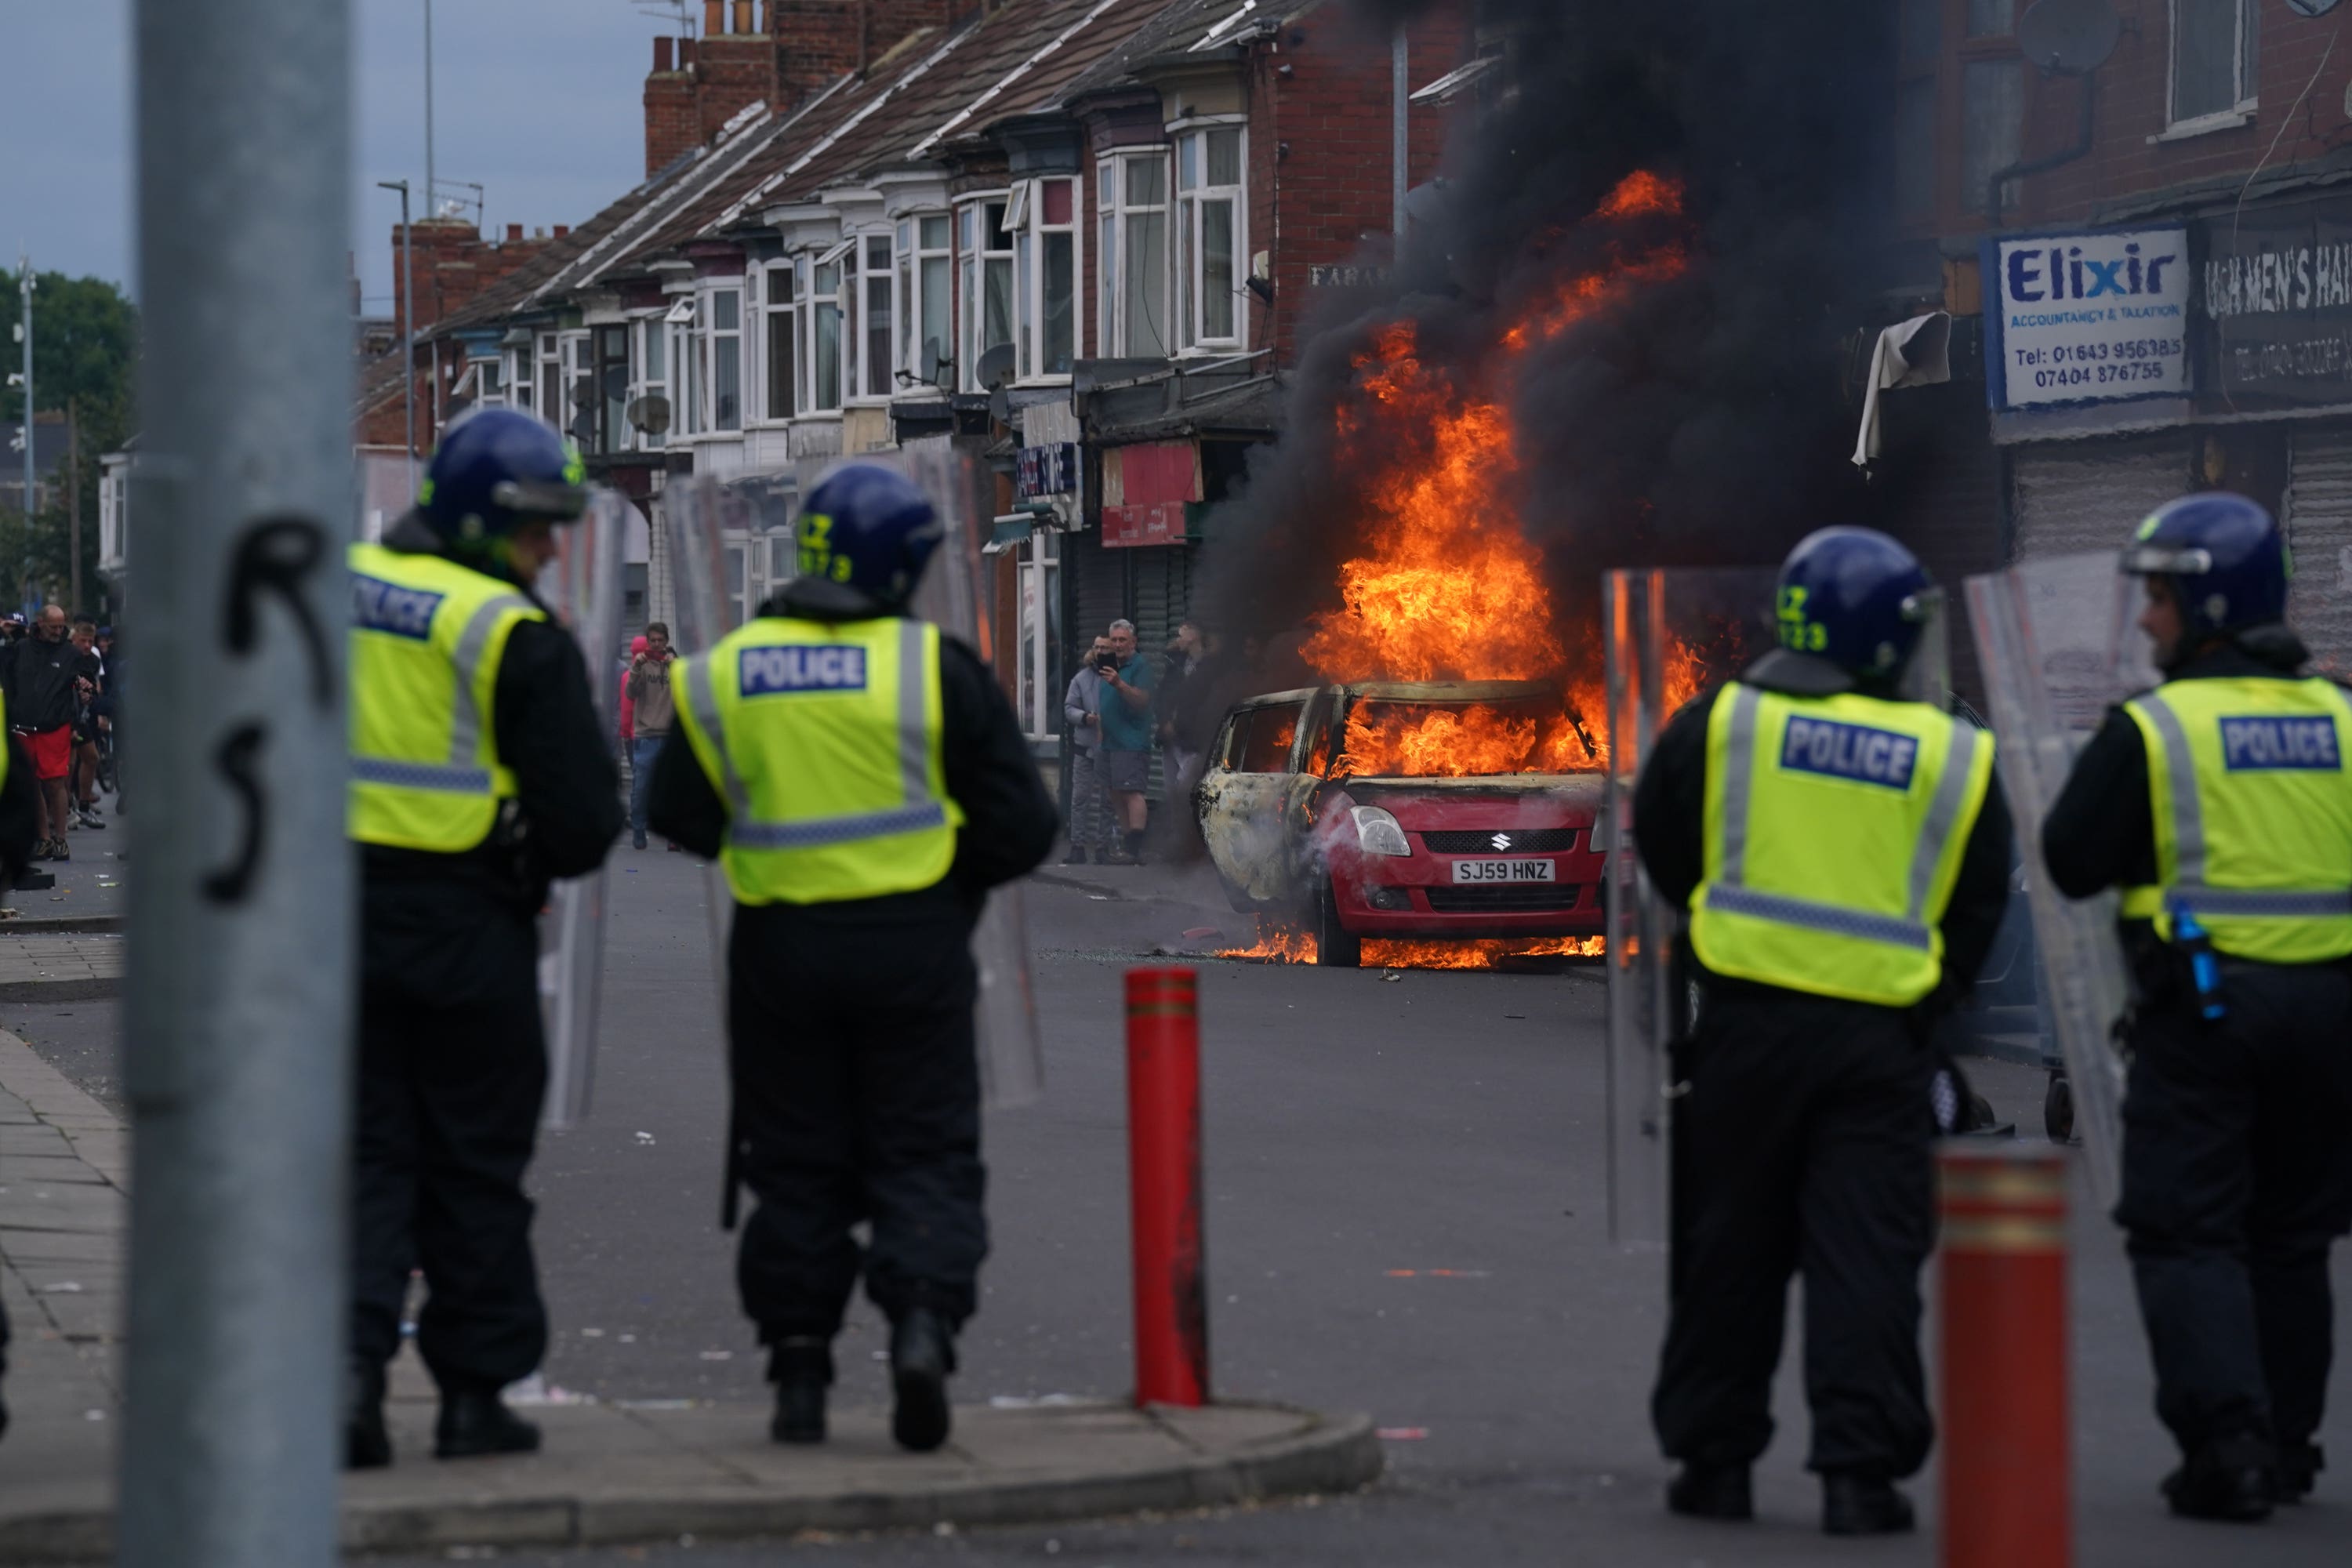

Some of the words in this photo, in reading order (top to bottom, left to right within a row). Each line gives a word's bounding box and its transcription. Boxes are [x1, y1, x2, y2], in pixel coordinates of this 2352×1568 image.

[2008, 242, 2176, 303] Elixir
[2010, 308, 2103, 328] ACCOUNTANCY
[2107, 307, 2117, 321] &
[2120, 303, 2180, 320] TAXATION
[2015, 347, 2047, 366] Tel:
[2035, 367, 2091, 387] 07404
[2097, 361, 2164, 383] 876755
[742, 648, 863, 691] POLICE
[1786, 720, 1914, 782] POLICE
[2225, 720, 2339, 764] POLICE
[1460, 862, 1508, 880] SJ59
[1512, 862, 1548, 880] HNZ
